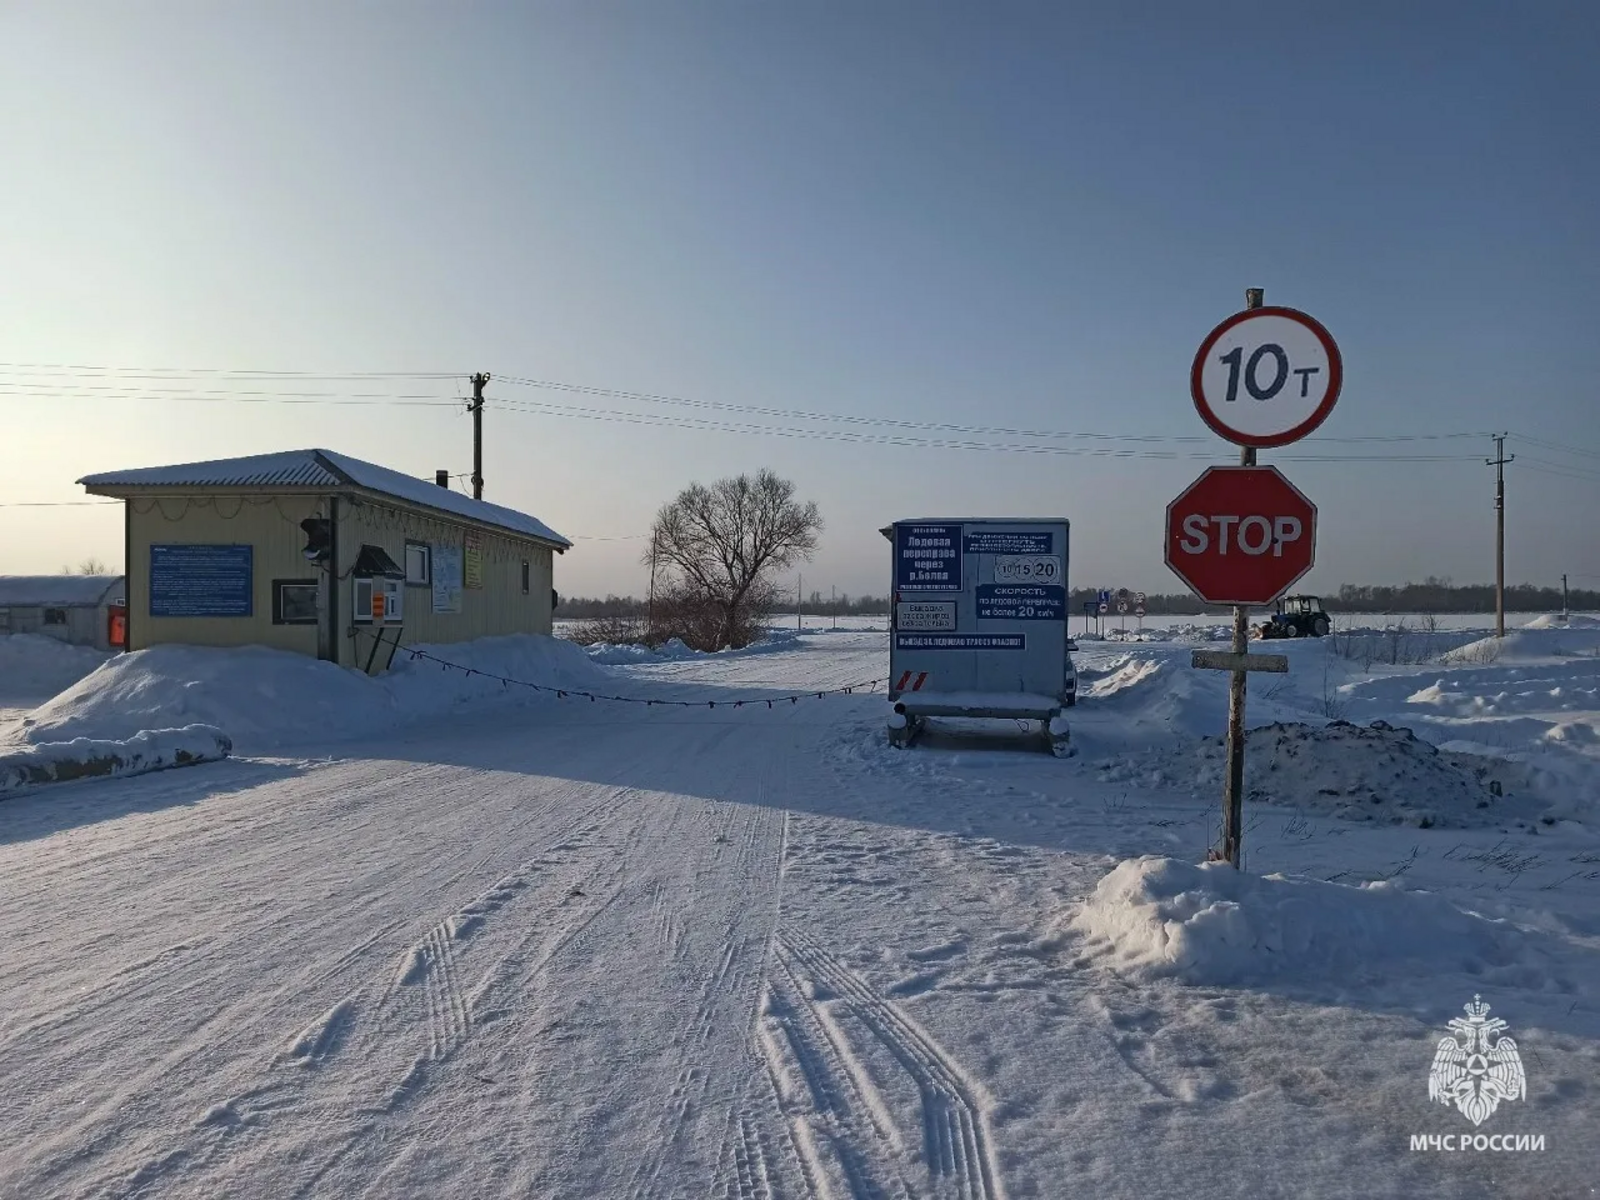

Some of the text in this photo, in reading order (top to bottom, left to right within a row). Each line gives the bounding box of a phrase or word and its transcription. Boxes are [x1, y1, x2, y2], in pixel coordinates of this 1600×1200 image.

[1180, 513, 1302, 557] STOP
[908, 536, 951, 548] Ледовая
[903, 549, 956, 559] переправа
[914, 560, 944, 570] через
[1016, 564, 1031, 576] 15
[1035, 562, 1055, 577] 20
[994, 588, 1046, 596] СКОРОСТЬ
[1018, 605, 1035, 617] 20
